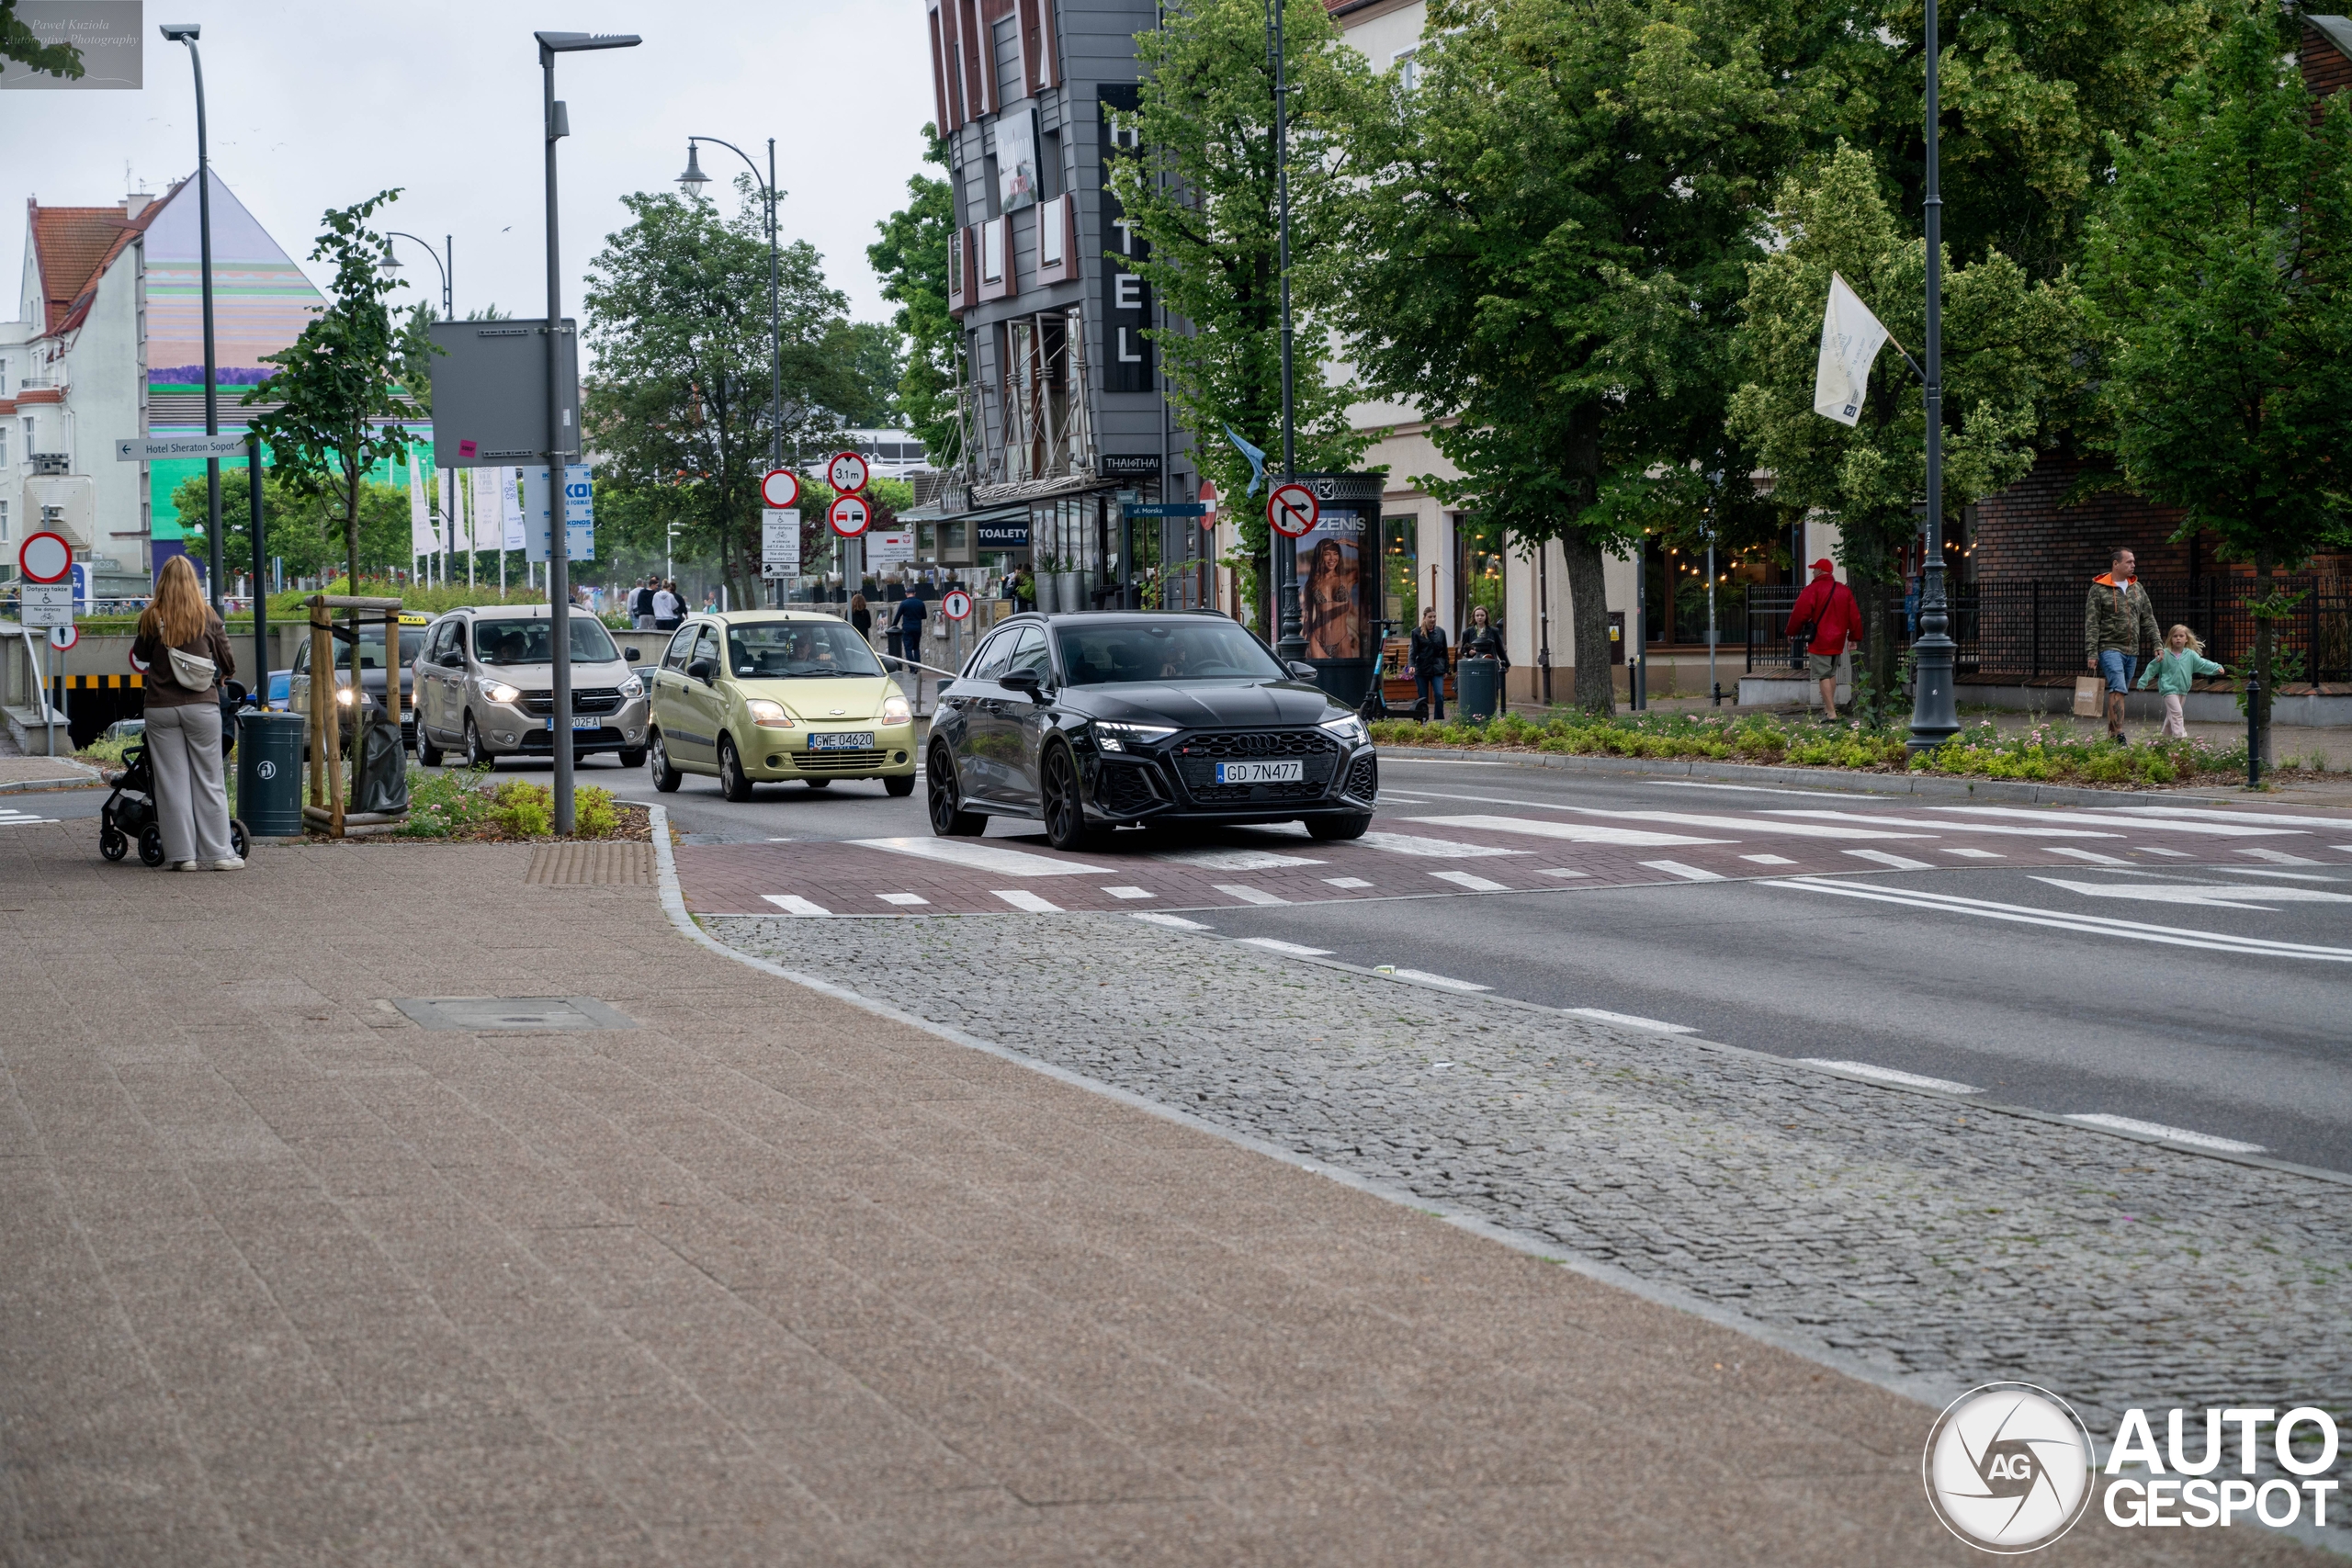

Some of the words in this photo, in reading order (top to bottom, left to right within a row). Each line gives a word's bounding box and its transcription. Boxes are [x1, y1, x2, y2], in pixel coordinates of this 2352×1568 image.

[146, 444, 168, 454] Hotel
[171, 442, 208, 453] Sheraton
[210, 442, 234, 452] Sopot
[835, 468, 849, 479] 3,1
[978, 529, 1028, 538] TOALETY
[92, 560, 116, 569] KIOSK
[815, 735, 836, 746] GWE
[839, 734, 872, 746] 04620
[1227, 765, 1247, 781] GD
[1252, 763, 1298, 780] 7N477
